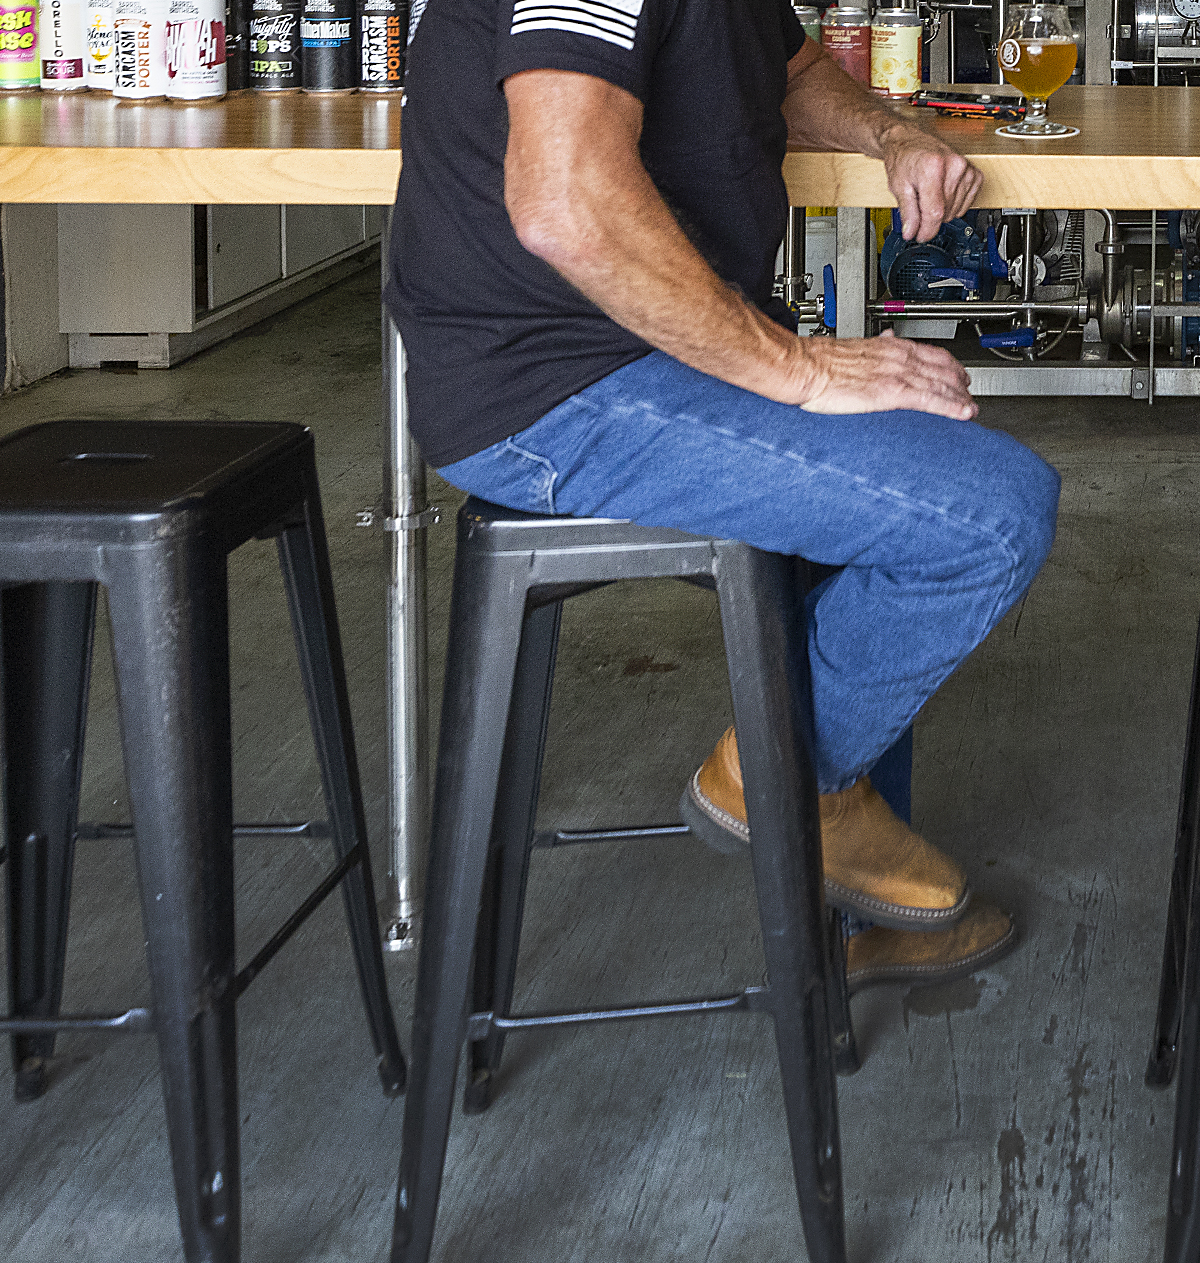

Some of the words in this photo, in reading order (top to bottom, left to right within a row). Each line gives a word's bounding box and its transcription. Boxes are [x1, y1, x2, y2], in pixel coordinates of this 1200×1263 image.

[0, 10, 32, 31] SH
[252, 3, 282, 11] BROTHERS
[46, 66, 75, 75] SOUR
[121, 30, 136, 87] SARCASM
[138, 30, 150, 88] PORTER
[253, 60, 282, 73] IPA
[361, 15, 369, 81] DARK
[369, 15, 387, 81] SARCASM
[387, 15, 400, 81] PORTER
